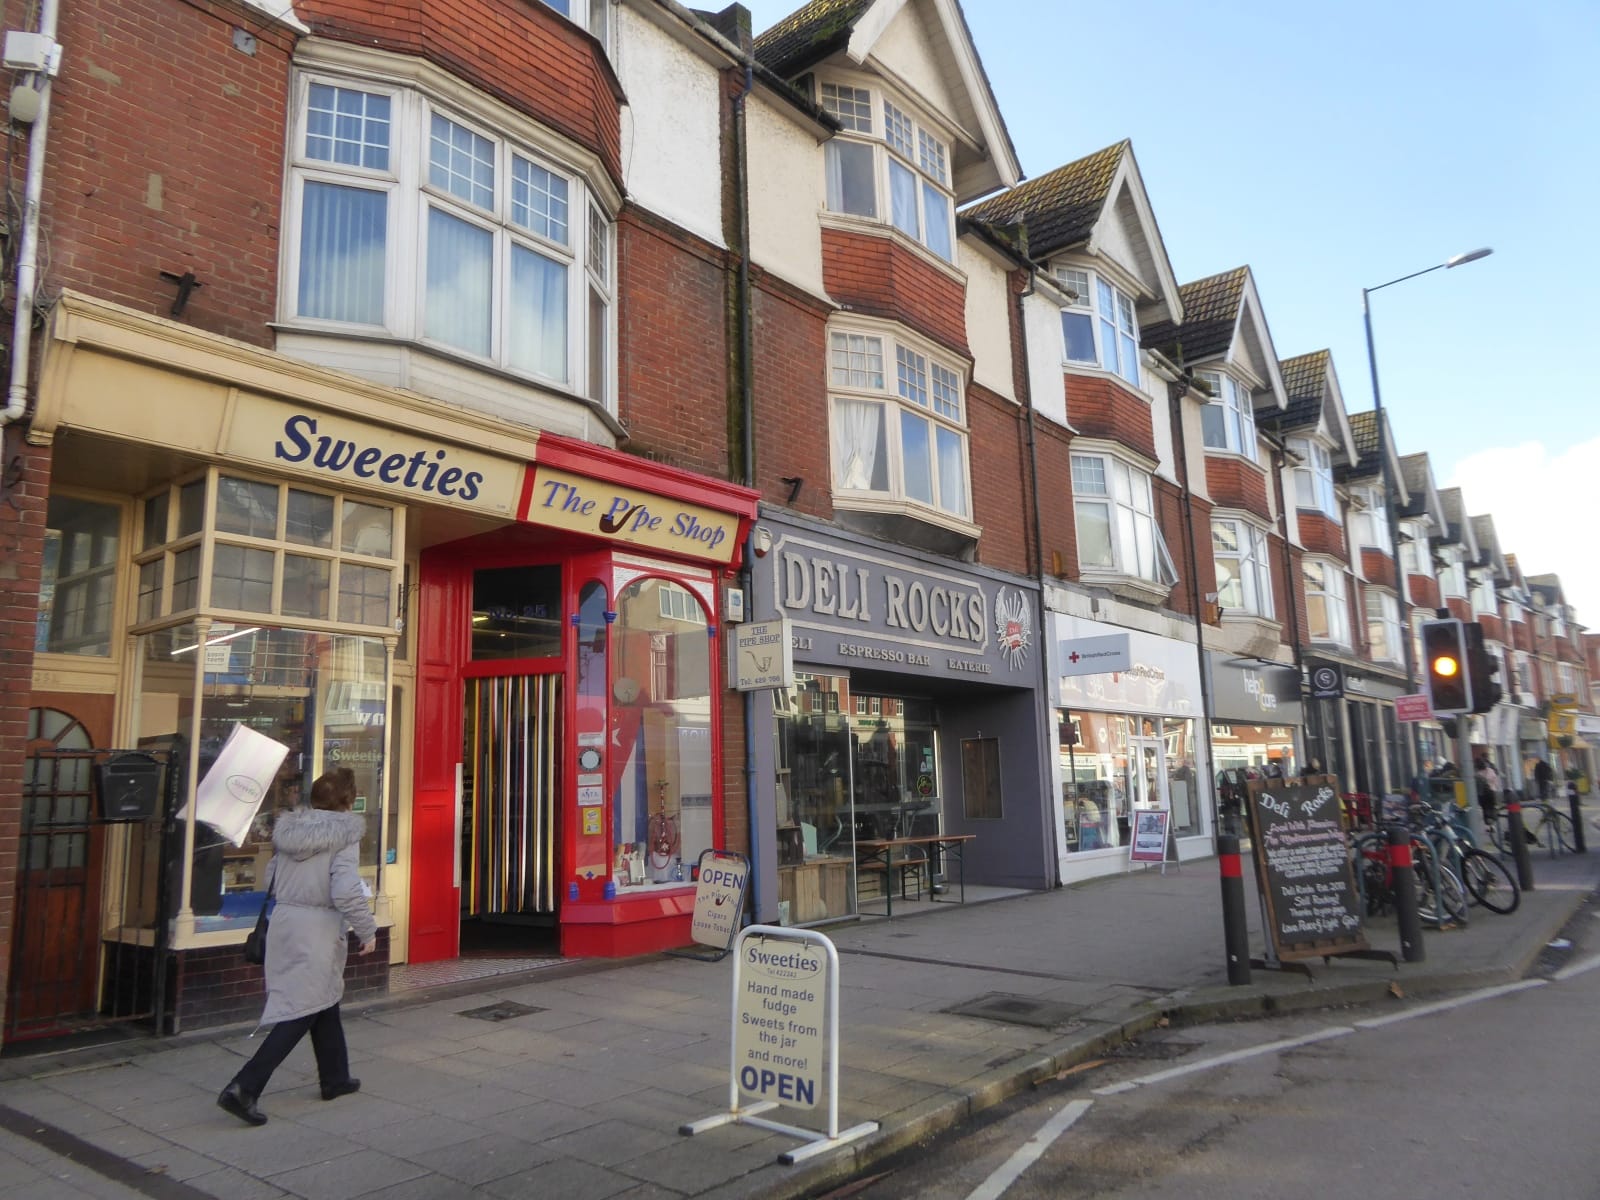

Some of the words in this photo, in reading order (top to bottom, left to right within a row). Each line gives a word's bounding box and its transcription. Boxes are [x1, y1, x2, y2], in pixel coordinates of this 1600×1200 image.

[275, 415, 483, 500] Sweeties
[543, 480, 596, 516] The
[669, 512, 725, 550] Shop
[783, 551, 871, 622] DELI
[884, 575, 984, 642] ROCKS
[740, 637, 758, 647] PIPE
[759, 633, 780, 645] SHOP
[752, 626, 768, 636] THE
[792, 636, 813, 650] ELI
[839, 642, 904, 663] ESPRESSO
[907, 653, 932, 667] BAR
[948, 658, 992, 675] EATERIE
[1259, 792, 1290, 818] Deli
[1300, 786, 1335, 817] Rocks
[702, 868, 744, 891] OPEN
[707, 910, 728, 921] Cigars
[748, 947, 819, 973] Sweeties
[747, 980, 778, 997] Hand
[781, 986, 815, 1003] made
[762, 997, 798, 1017] fudge
[742, 1012, 785, 1031] Sweets
[788, 1020, 818, 1037] from
[759, 1030, 778, 1045] the
[780, 1034, 798, 1049] jar
[748, 1049, 769, 1062] and
[773, 1056, 809, 1071] more!
[740, 1065, 815, 1106] OPEN
